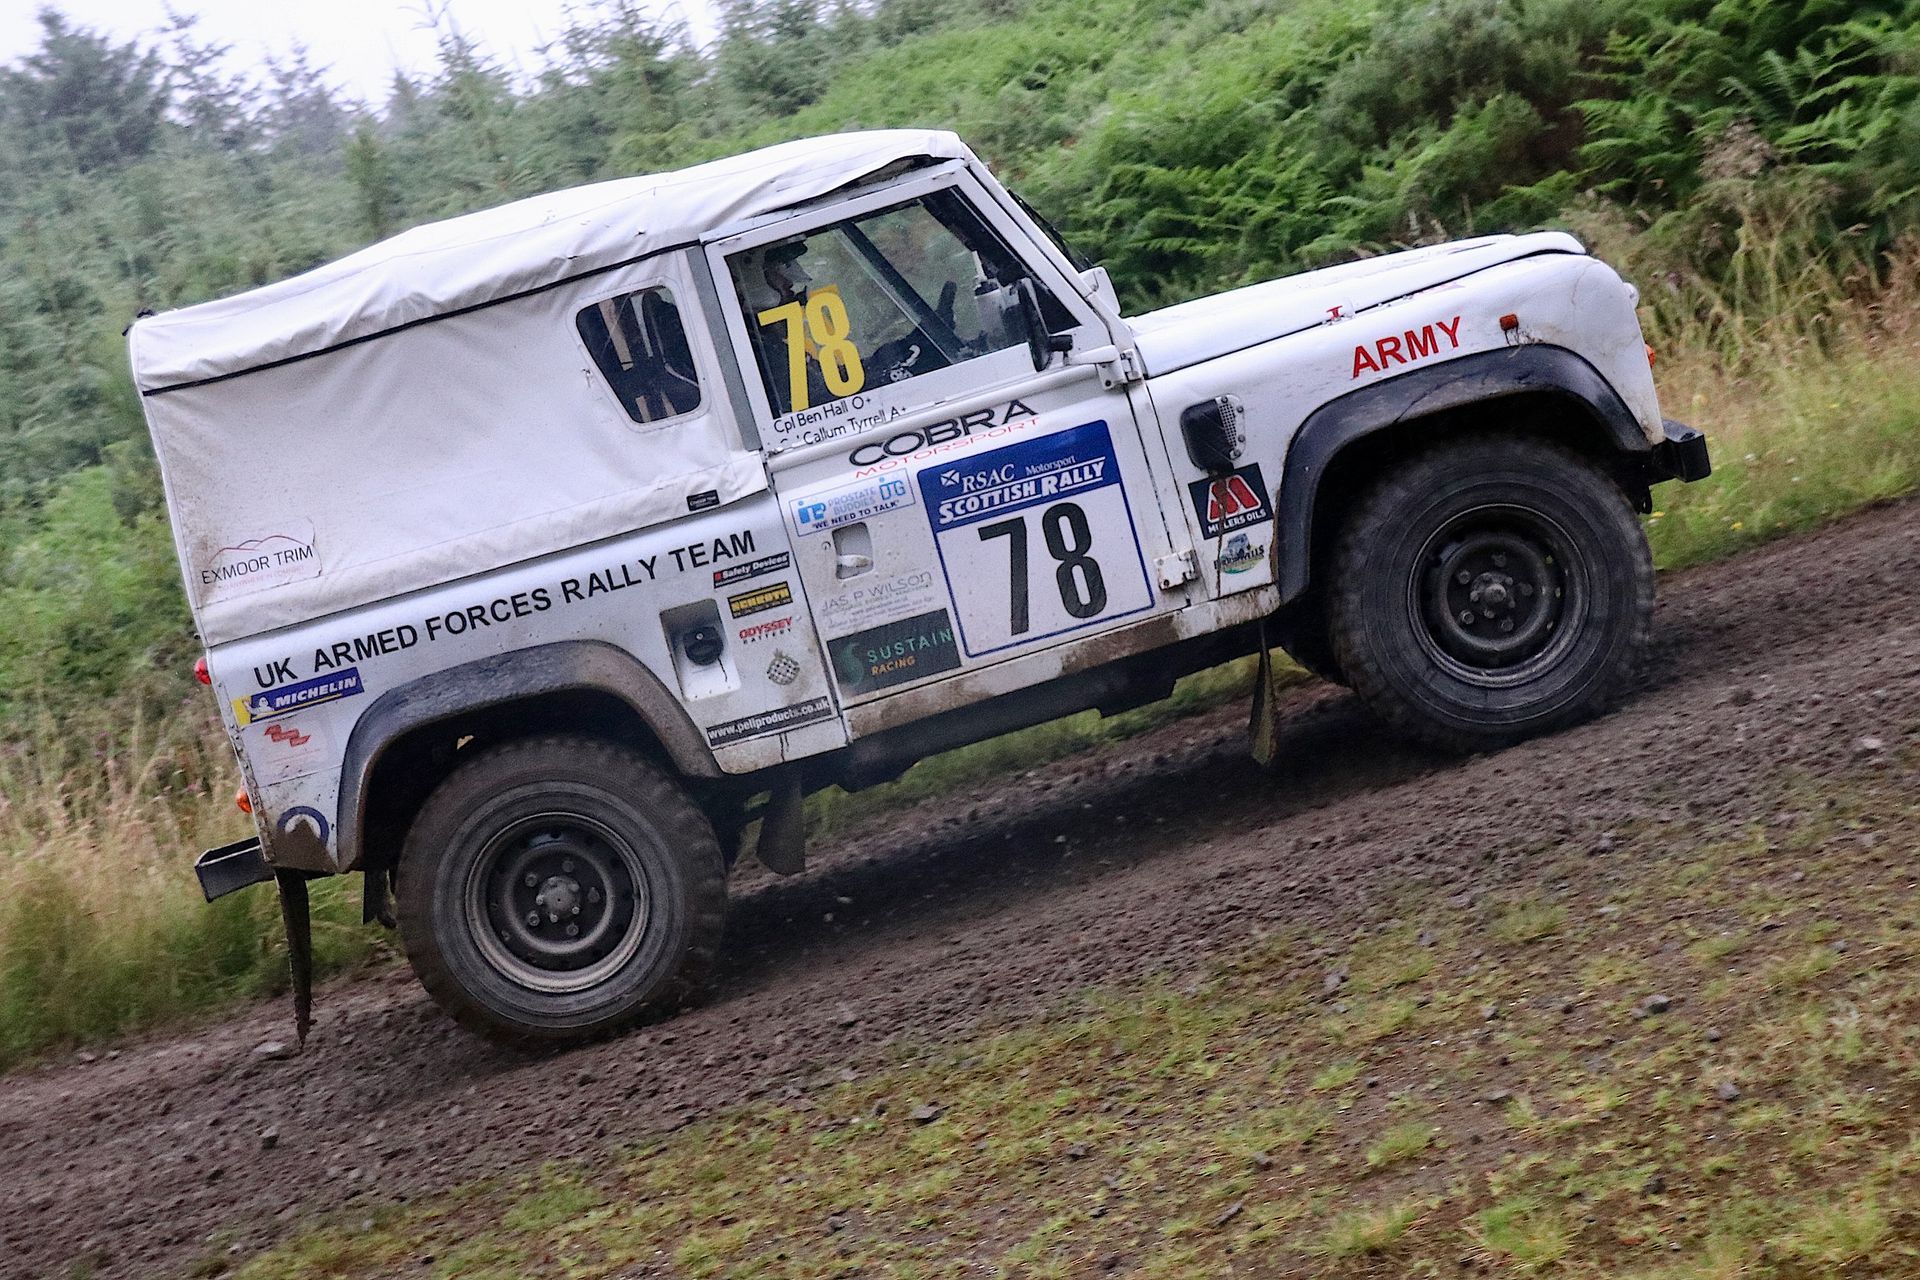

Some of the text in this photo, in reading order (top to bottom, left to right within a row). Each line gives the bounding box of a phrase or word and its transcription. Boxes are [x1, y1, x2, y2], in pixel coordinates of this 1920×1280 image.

[758, 291, 865, 412] 78
[1352, 315, 1461, 379] ARMY
[773, 396, 871, 434] Cpl Ben Hall O+
[803, 425, 847, 445] Callum
[847, 410, 887, 434] Tyrrell
[848, 399, 1039, 467] COBRA
[856, 417, 1041, 479] MOTORSPORT
[962, 455, 1076, 494] RSAC Motorsport
[827, 486, 877, 506] PROSTATE
[833, 497, 877, 515] BUDDIES
[938, 480, 1037, 525] SCOTTISH
[1041, 461, 1106, 497] RALLY
[831, 512, 857, 525] NEED
[859, 508, 872, 517] TO
[1246, 509, 1267, 522] OILS
[201, 556, 270, 585] EXMOOR
[273, 545, 314, 566] TRIM
[723, 565, 751, 579] Safety
[752, 555, 788, 570] Devices
[976, 502, 1108, 637] 78
[253, 657, 298, 689] UK
[313, 624, 419, 673] ARMED
[425, 587, 552, 641] FORCES
[560, 555, 657, 604] RALLY
[668, 529, 756, 572] TEAM
[822, 595, 848, 612] JAS
[853, 590, 864, 600] P
[739, 617, 792, 639] ODYSSEY
[866, 628, 953, 664] SUSTAIN
[870, 655, 916, 676] RACING
[275, 676, 358, 708] MICHELIN
